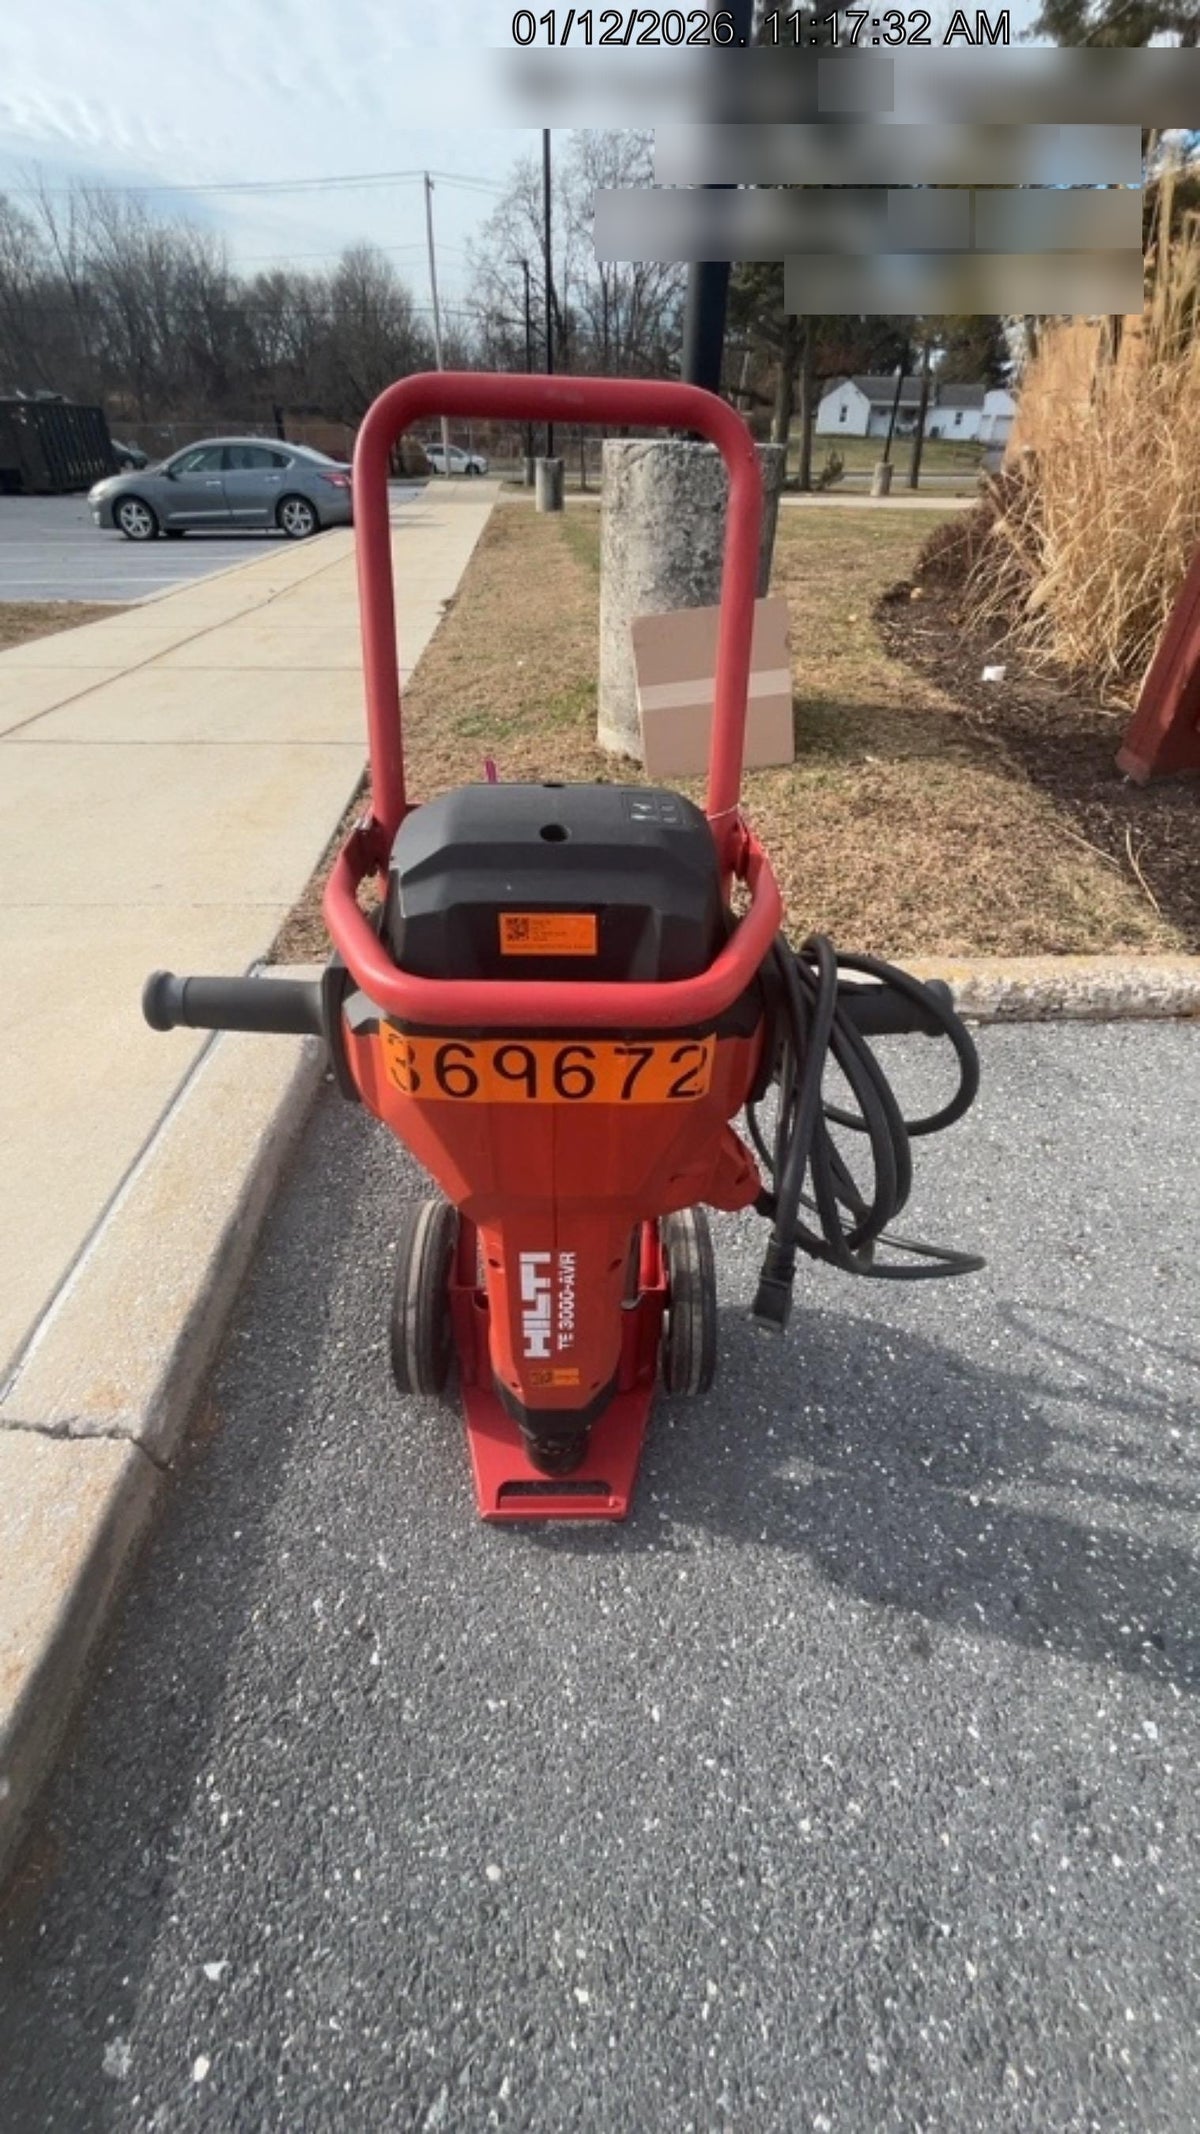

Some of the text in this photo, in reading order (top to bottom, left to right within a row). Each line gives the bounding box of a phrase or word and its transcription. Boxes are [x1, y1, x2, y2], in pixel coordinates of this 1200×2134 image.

[519, 1252, 551, 1358] HILTI
[557, 1251, 577, 1351] TE 3000-AVR
